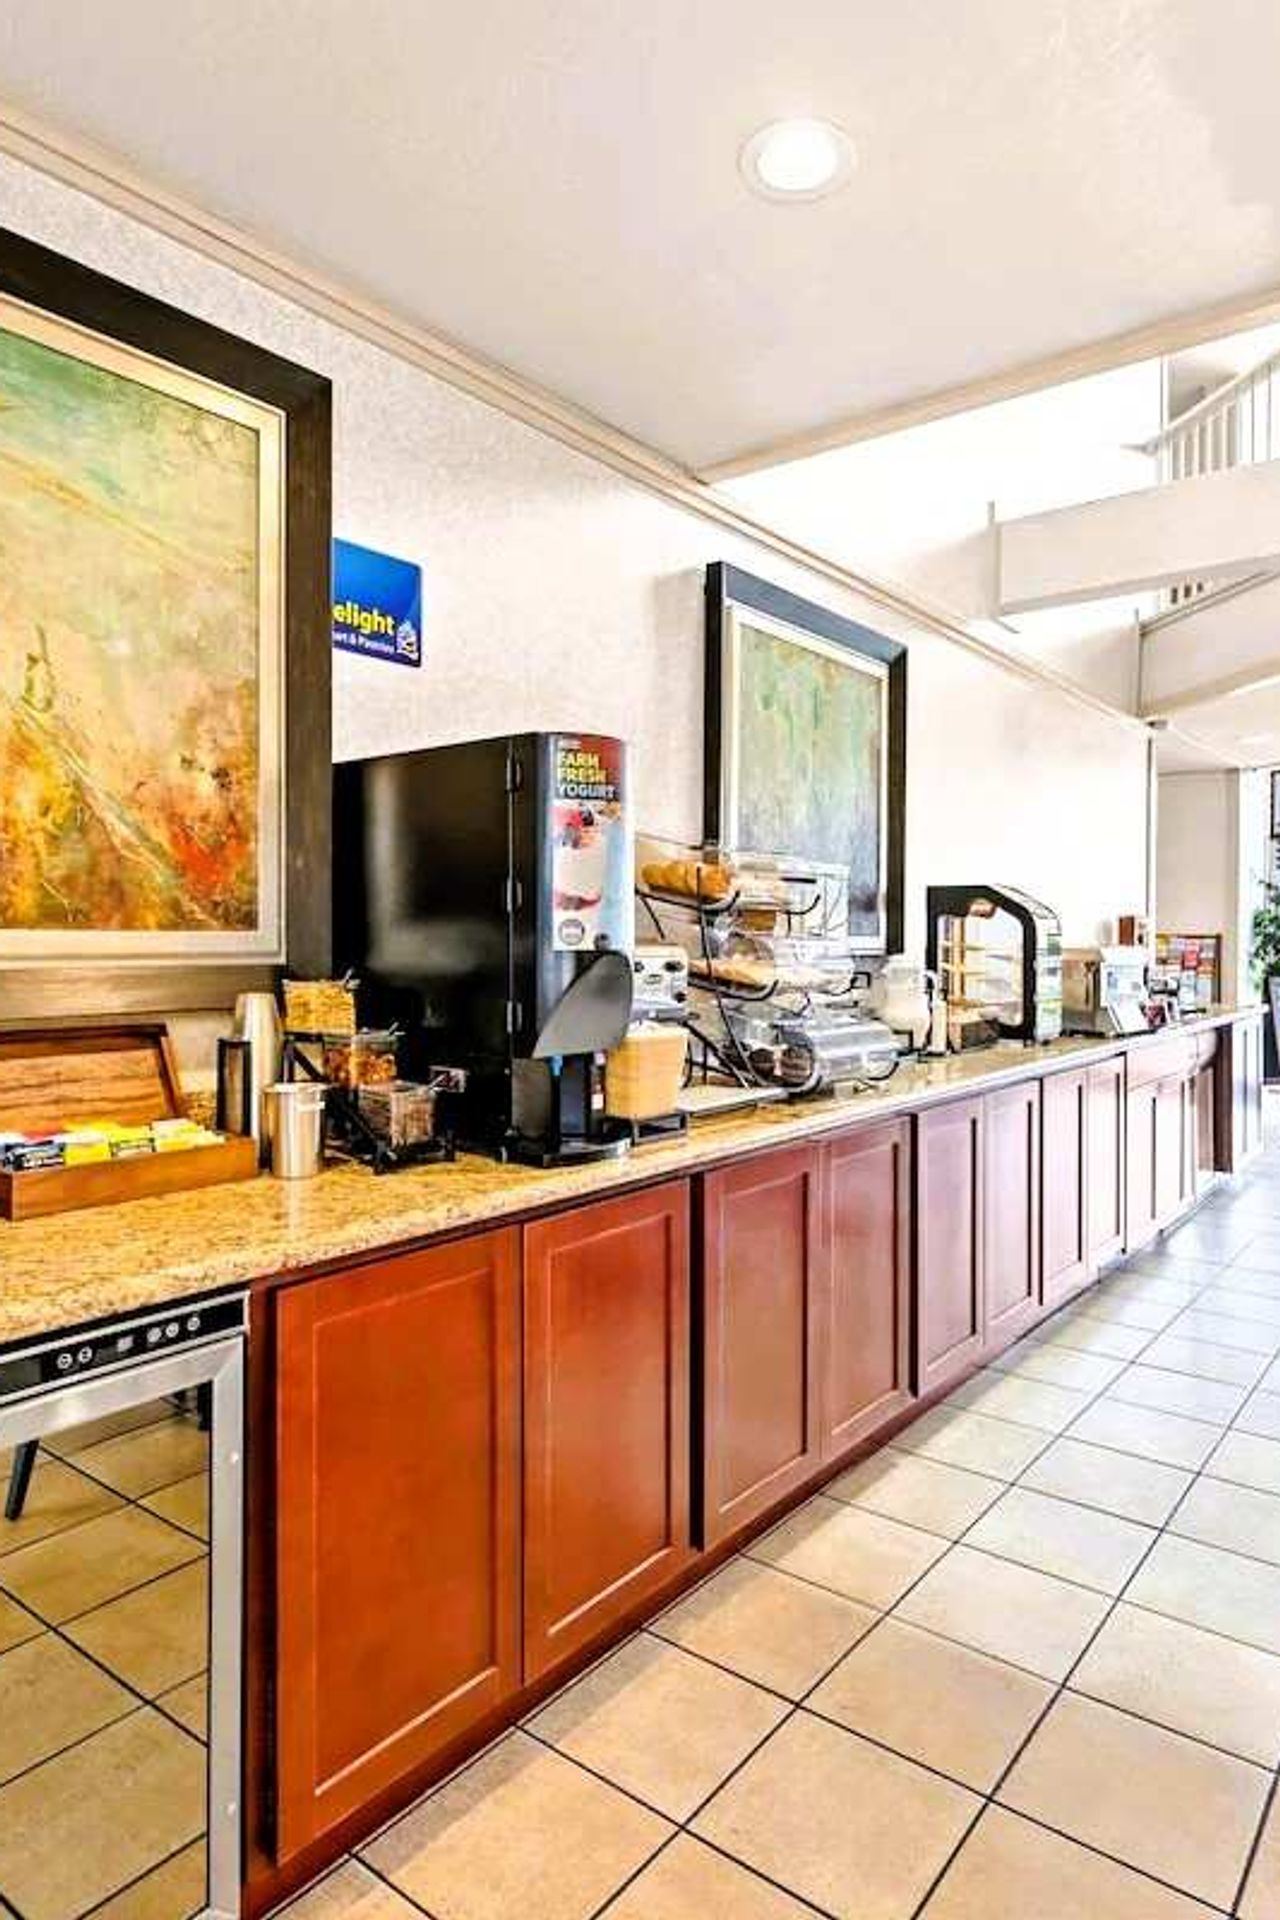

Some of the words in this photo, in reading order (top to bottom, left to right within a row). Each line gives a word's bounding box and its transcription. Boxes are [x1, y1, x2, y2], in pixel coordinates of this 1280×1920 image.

[332, 600, 395, 635] elight
[557, 751, 600, 767] FARM
[557, 767, 608, 784] FRESH
[557, 783, 615, 799] YOGURT
